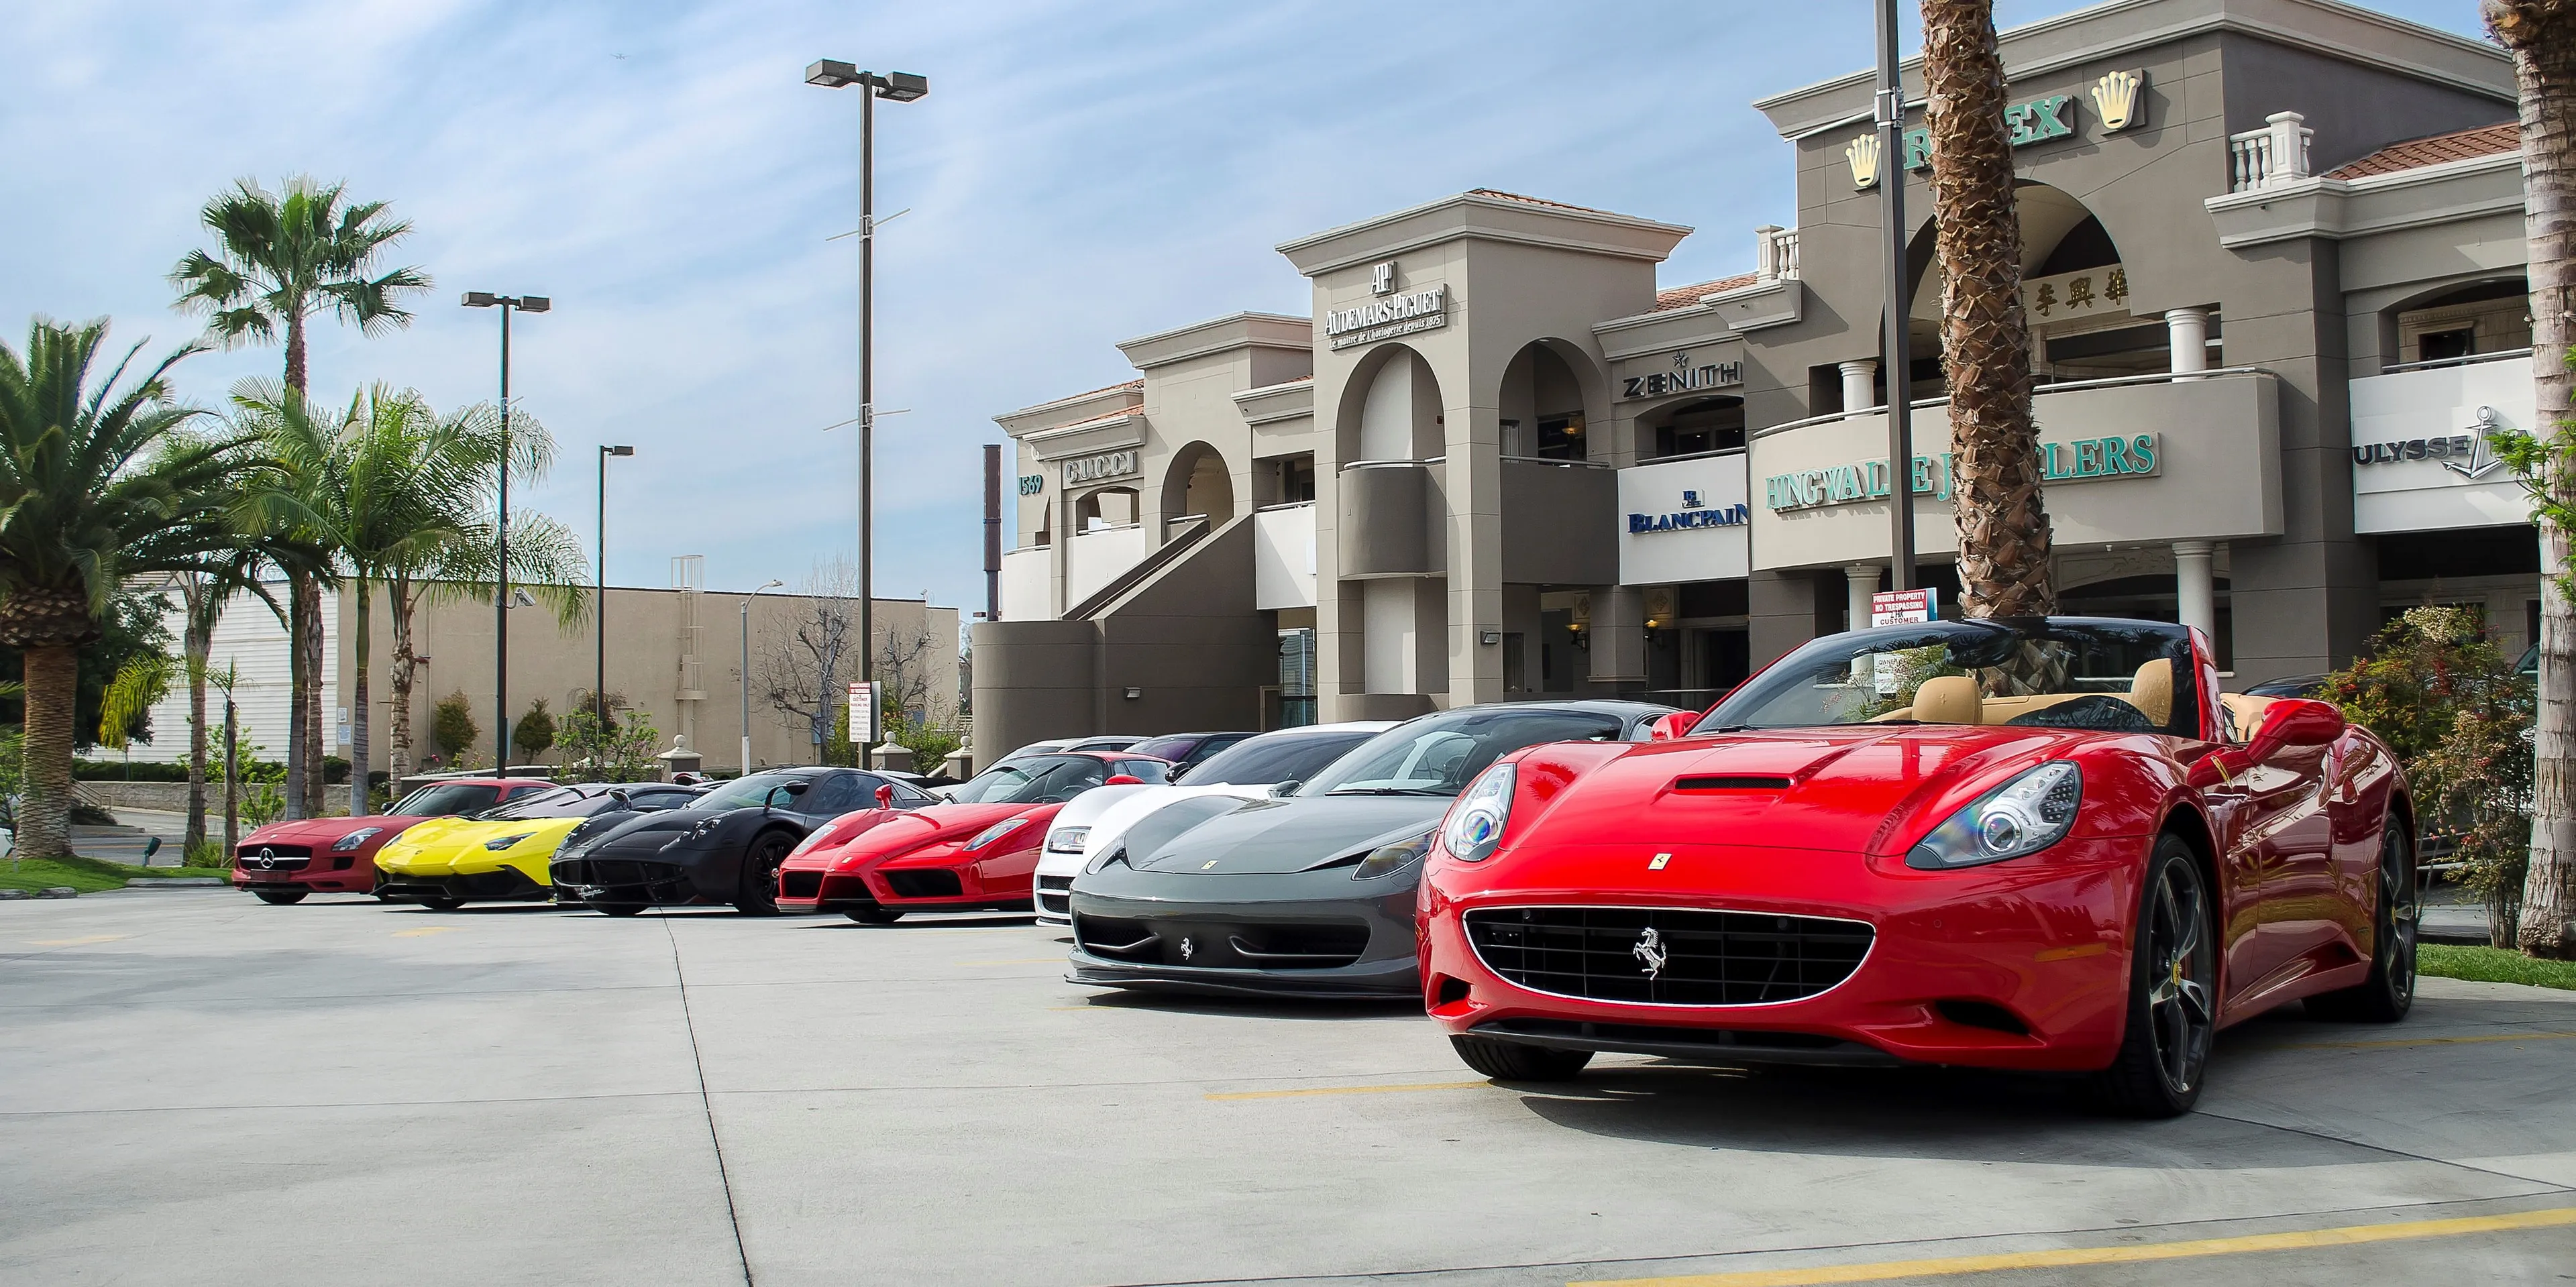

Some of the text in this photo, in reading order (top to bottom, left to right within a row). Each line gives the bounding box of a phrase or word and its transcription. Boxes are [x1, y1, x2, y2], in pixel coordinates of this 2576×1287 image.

[1902, 95, 2072, 170] REX
[1323, 289, 1444, 336] AUDEMARS PIGUET
[1328, 339, 1337, 349] Le
[1358, 332, 1366, 341] de
[1404, 319, 1425, 332] depuis
[1426, 315, 1441, 327] 1875
[1623, 361, 1742, 398] ZENITH
[2353, 435, 2470, 465] ULYSSE
[1065, 451, 1137, 483] GUCCI
[1766, 470, 1823, 510] HING
[1822, 465, 1865, 501] WA
[1937, 435, 2155, 502] JLERS
[1018, 475, 1042, 496] 1569
[1627, 504, 1748, 533] BLANCPAIN
[1873, 592, 1925, 603] PRIVATE PROPERTY
[1875, 601, 1923, 612] NO TRESPASSING
[1880, 617, 1919, 625] CUSTOMER
